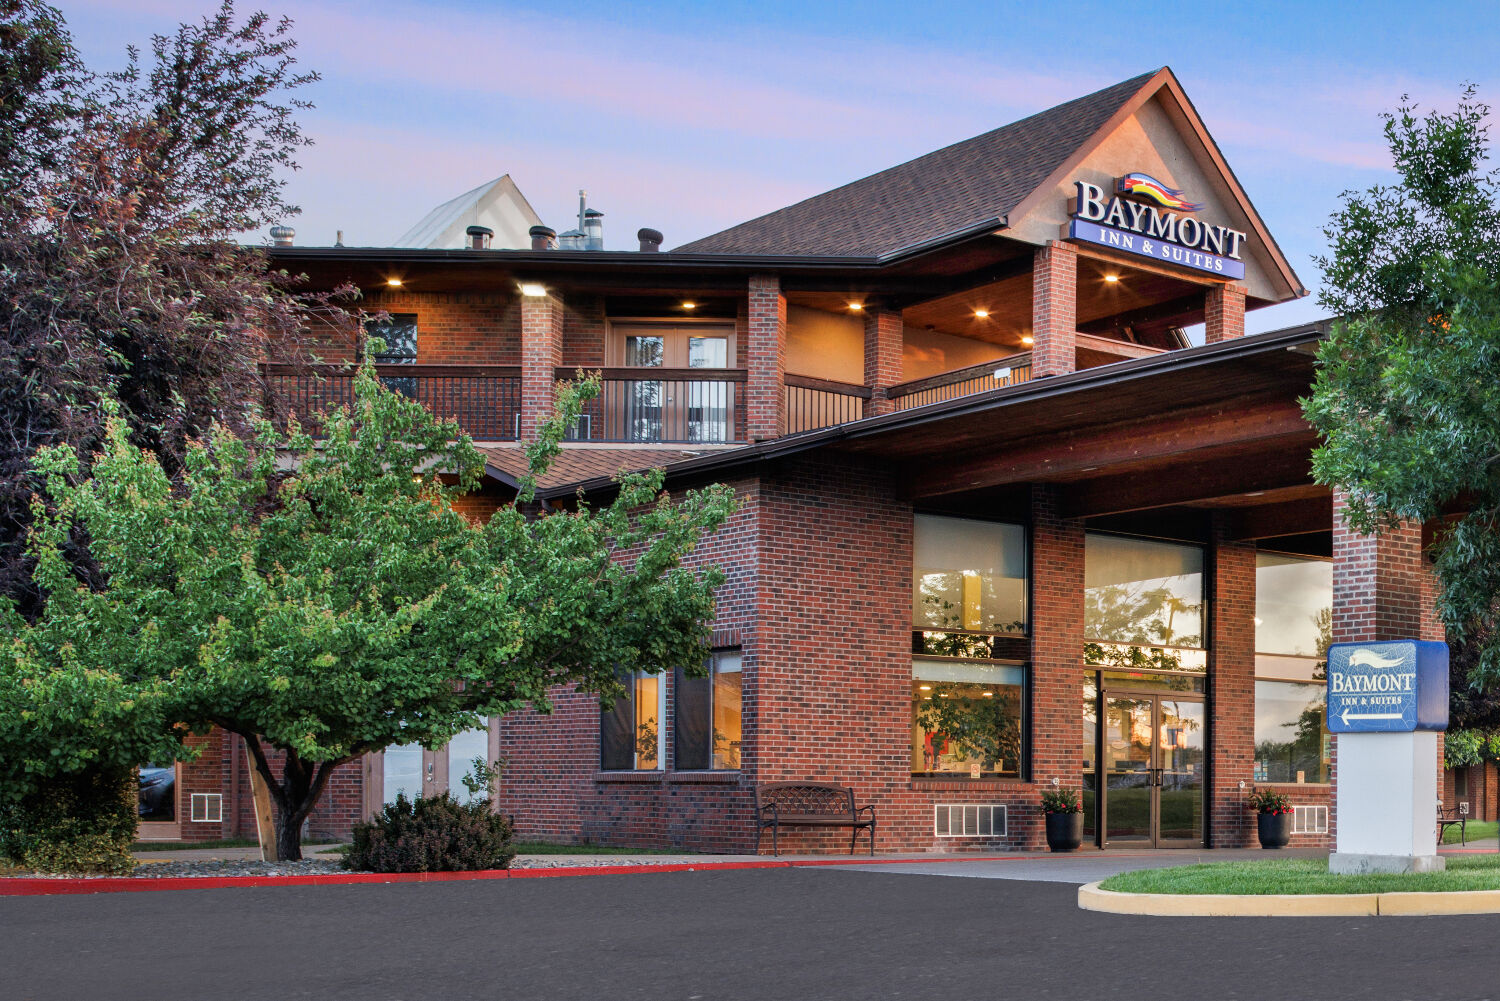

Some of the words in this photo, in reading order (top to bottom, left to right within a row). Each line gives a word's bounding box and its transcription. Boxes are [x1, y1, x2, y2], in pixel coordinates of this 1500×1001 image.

[1075, 181, 1246, 260] BAYMONT
[1100, 229, 1133, 249] INN
[1142, 240, 1153, 255] &
[1162, 245, 1223, 272] SUITES
[1331, 672, 1413, 693] BAYMONT
[1341, 697, 1358, 705] INN
[1361, 696, 1367, 705] &
[1370, 696, 1402, 705] SUITES
